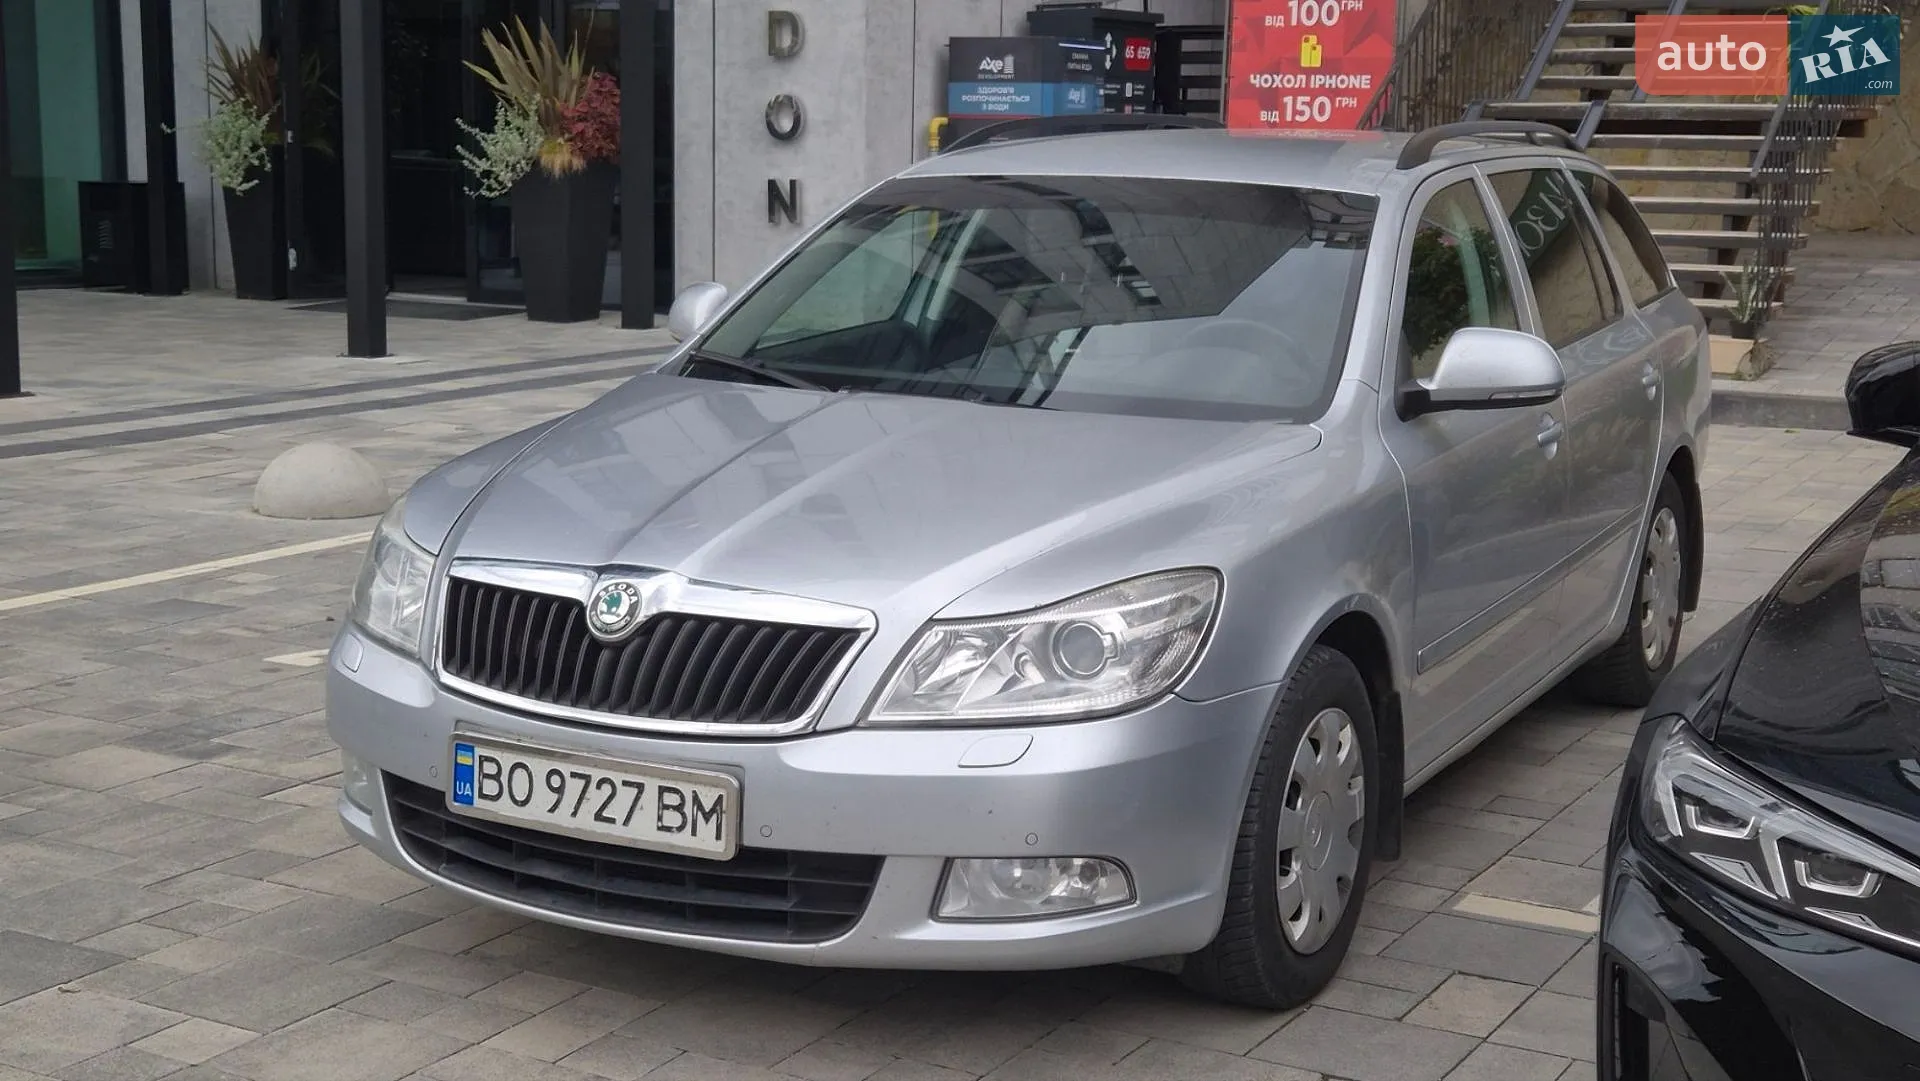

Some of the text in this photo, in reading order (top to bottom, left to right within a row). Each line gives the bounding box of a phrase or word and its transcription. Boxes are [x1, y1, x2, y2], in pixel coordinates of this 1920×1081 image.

[1265, 0, 1364, 27] ВІД 100 ГРН
[1250, 74, 1372, 89] ЧОХОЛ IPHONE
[1260, 96, 1357, 123] ВІД 150 ГРН
[456, 754, 725, 842] UA BO 9727 BM
